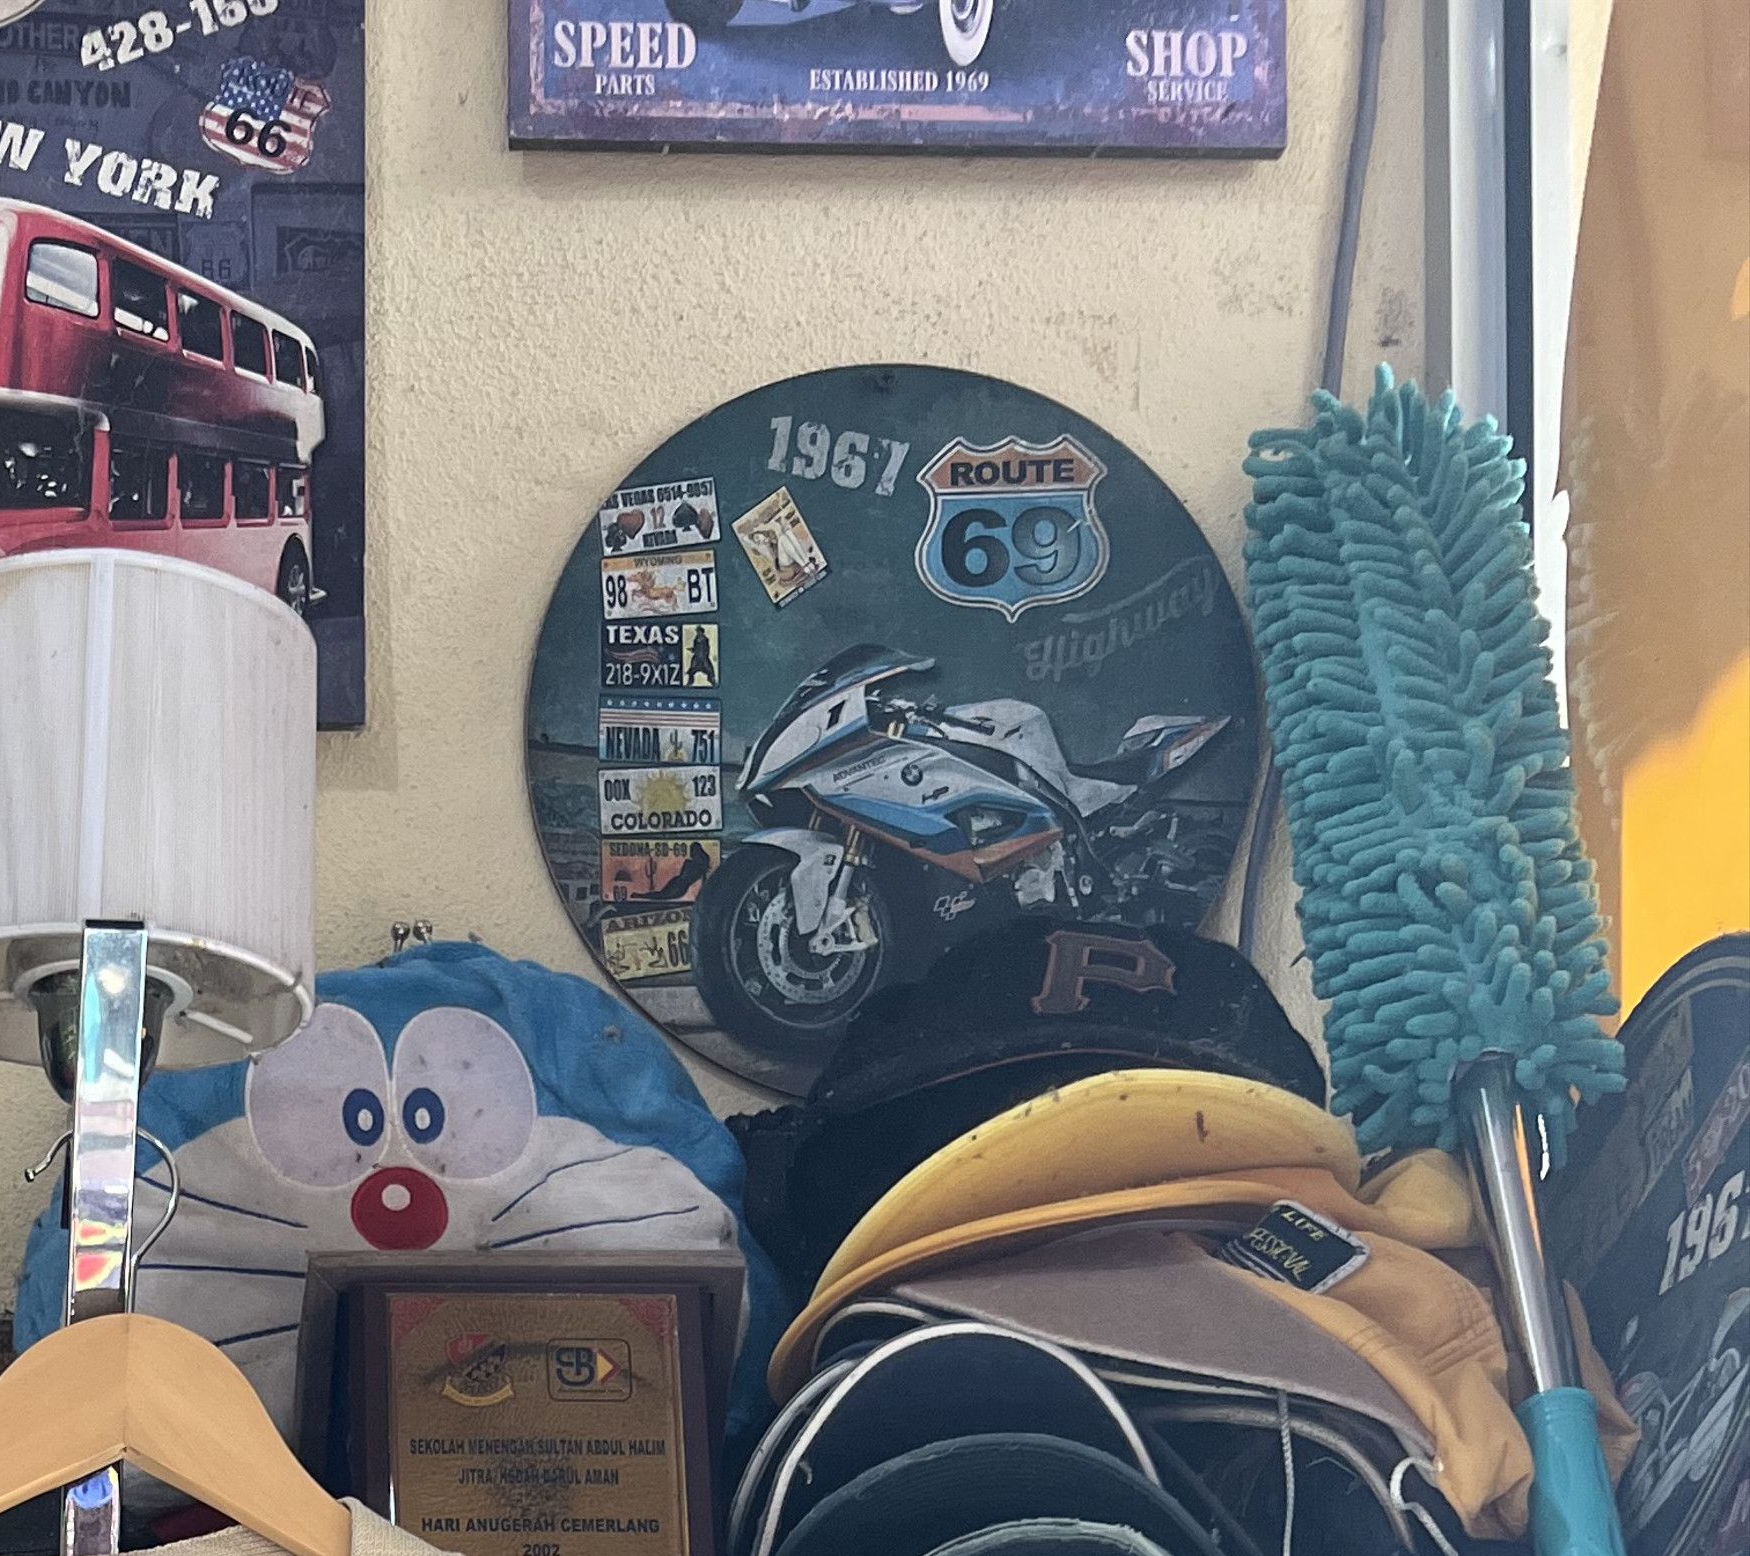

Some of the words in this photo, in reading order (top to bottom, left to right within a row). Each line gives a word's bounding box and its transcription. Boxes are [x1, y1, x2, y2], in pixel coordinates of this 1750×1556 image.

[552, 21, 697, 70] SPEED
[1125, 28, 1248, 80] SHOP
[594, 73, 657, 97] PARTS
[809, 68, 938, 93] ESTABLISHED
[945, 69, 990, 95] 1969
[1146, 80, 1228, 104] SERVICE
[225, 110, 292, 157] 66
[64, 138, 220, 219] YORK
[766, 414, 911, 498] 1967
[950, 459, 1075, 487] ROUTE
[941, 507, 1084, 588] 69
[606, 575, 628, 608] 98
[688, 567, 714, 603] BT
[606, 625, 679, 645] TEXAS
[606, 726, 661, 761] NEVADA
[691, 729, 715, 763] 751
[692, 774, 716, 798] 123
[611, 809, 712, 831] COLORADO
[1032, 930, 1177, 1015] P
[1658, 1170, 1750, 1296] 196
[409, 1439, 464, 1455] SEKOLAH
[586, 1439, 626, 1456] ABDUL
[628, 1440, 666, 1456] HALIM
[585, 1468, 619, 1486] AMAN
[421, 1517, 460, 1533] HARI
[465, 1517, 556, 1533] ANUGERAH
[561, 1518, 660, 1533] CEMERLANG
